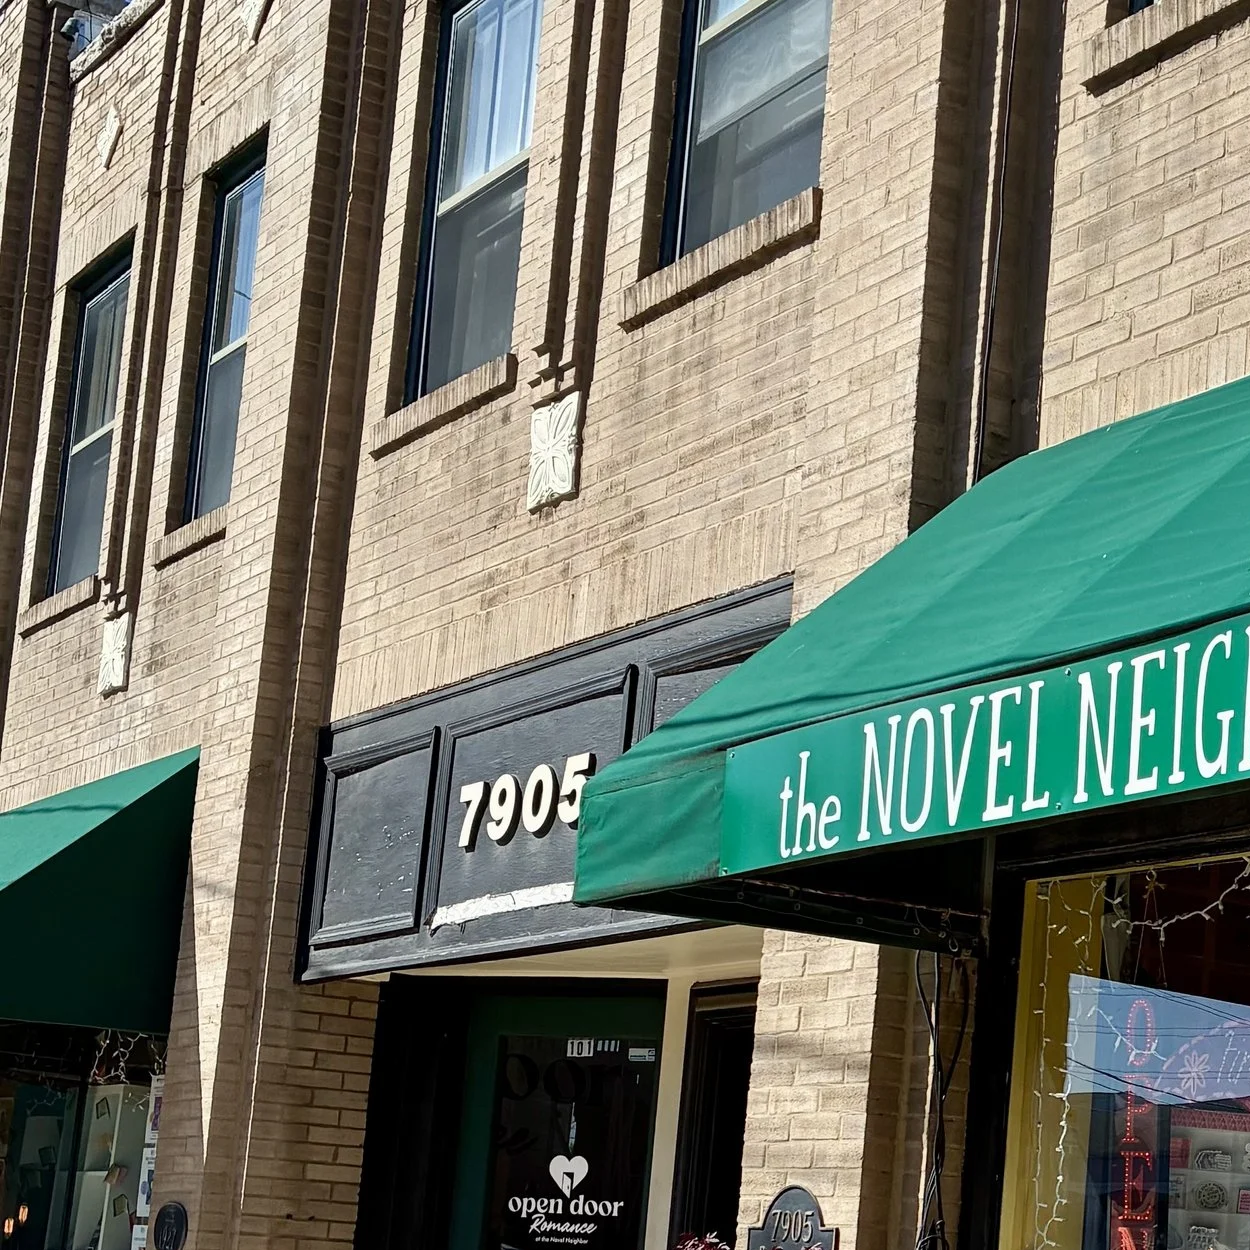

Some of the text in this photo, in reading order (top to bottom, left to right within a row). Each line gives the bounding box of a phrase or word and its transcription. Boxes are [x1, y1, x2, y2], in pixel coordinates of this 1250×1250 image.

[778, 751, 842, 859] the
[857, 680, 1050, 843] NOVEL
[458, 752, 591, 849] 7905
[569, 1040, 593, 1056] 101
[508, 1195, 624, 1218] open door
[529, 1213, 598, 1234] Romance
[772, 1209, 815, 1243] 7905
